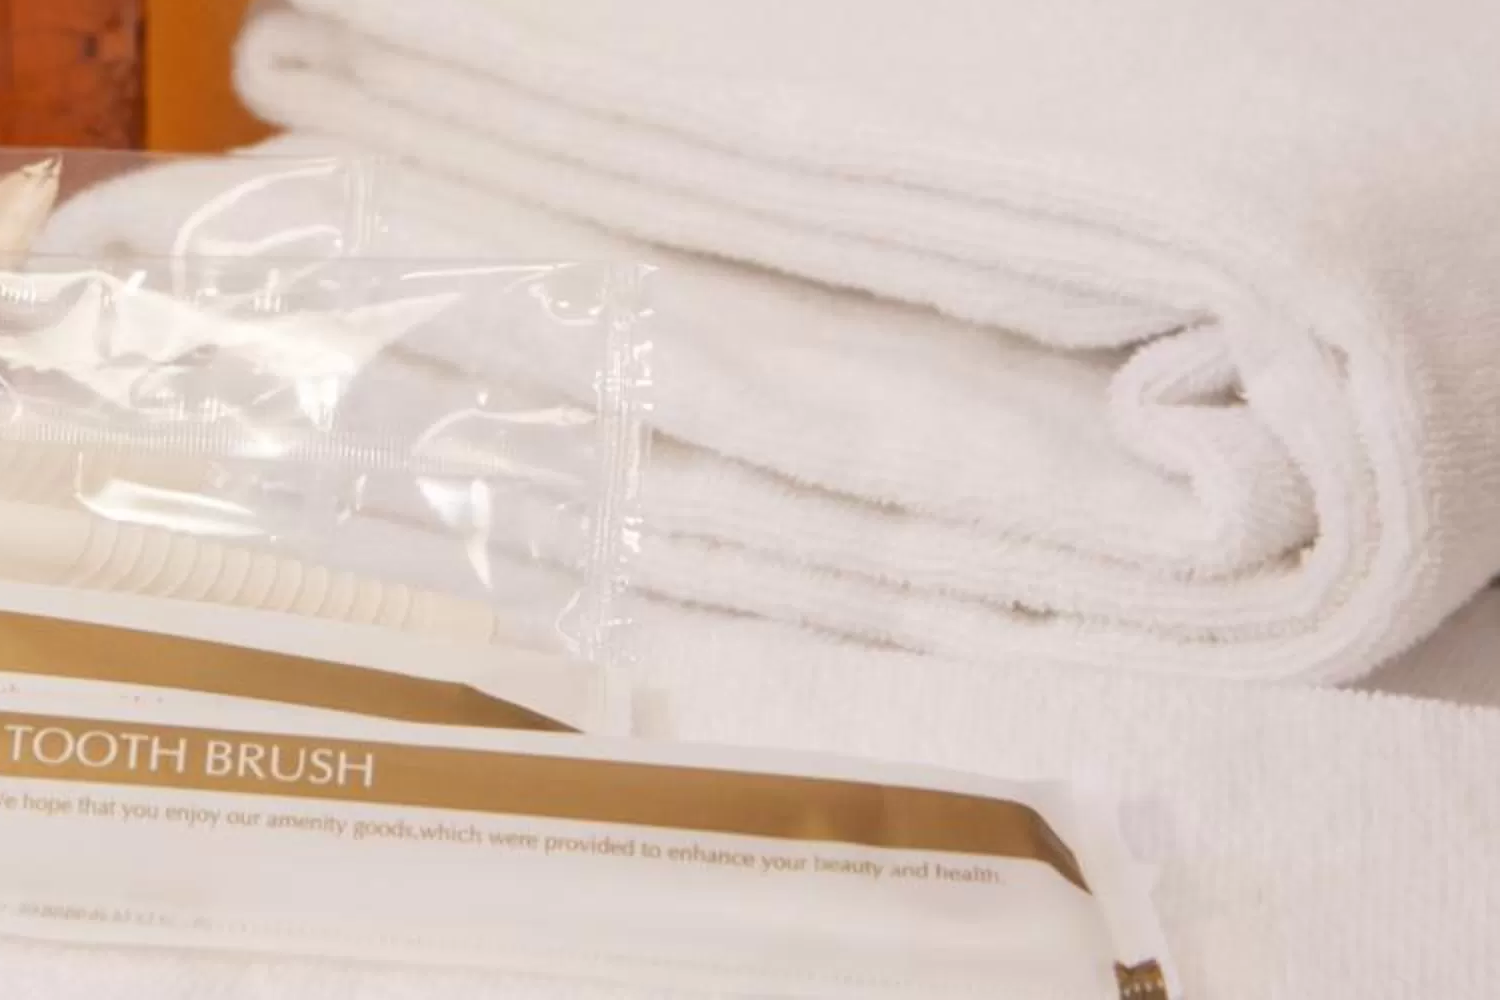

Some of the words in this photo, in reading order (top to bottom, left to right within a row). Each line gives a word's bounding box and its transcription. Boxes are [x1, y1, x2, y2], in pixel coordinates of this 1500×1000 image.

[4, 723, 188, 774] TOOTH
[205, 739, 374, 788] BRUSH
[23, 792, 72, 816] hope
[77, 793, 116, 818] that
[121, 801, 159, 823] you
[165, 802, 221, 828] enjoy
[227, 809, 261, 826] our
[266, 811, 347, 838] amenity
[488, 830, 538, 849] were
[544, 834, 635, 858] provided
[641, 840, 661, 860] to
[667, 841, 756, 868] enhance
[760, 853, 808, 874] your
[813, 855, 885, 880] beauty
[889, 861, 929, 880] and
